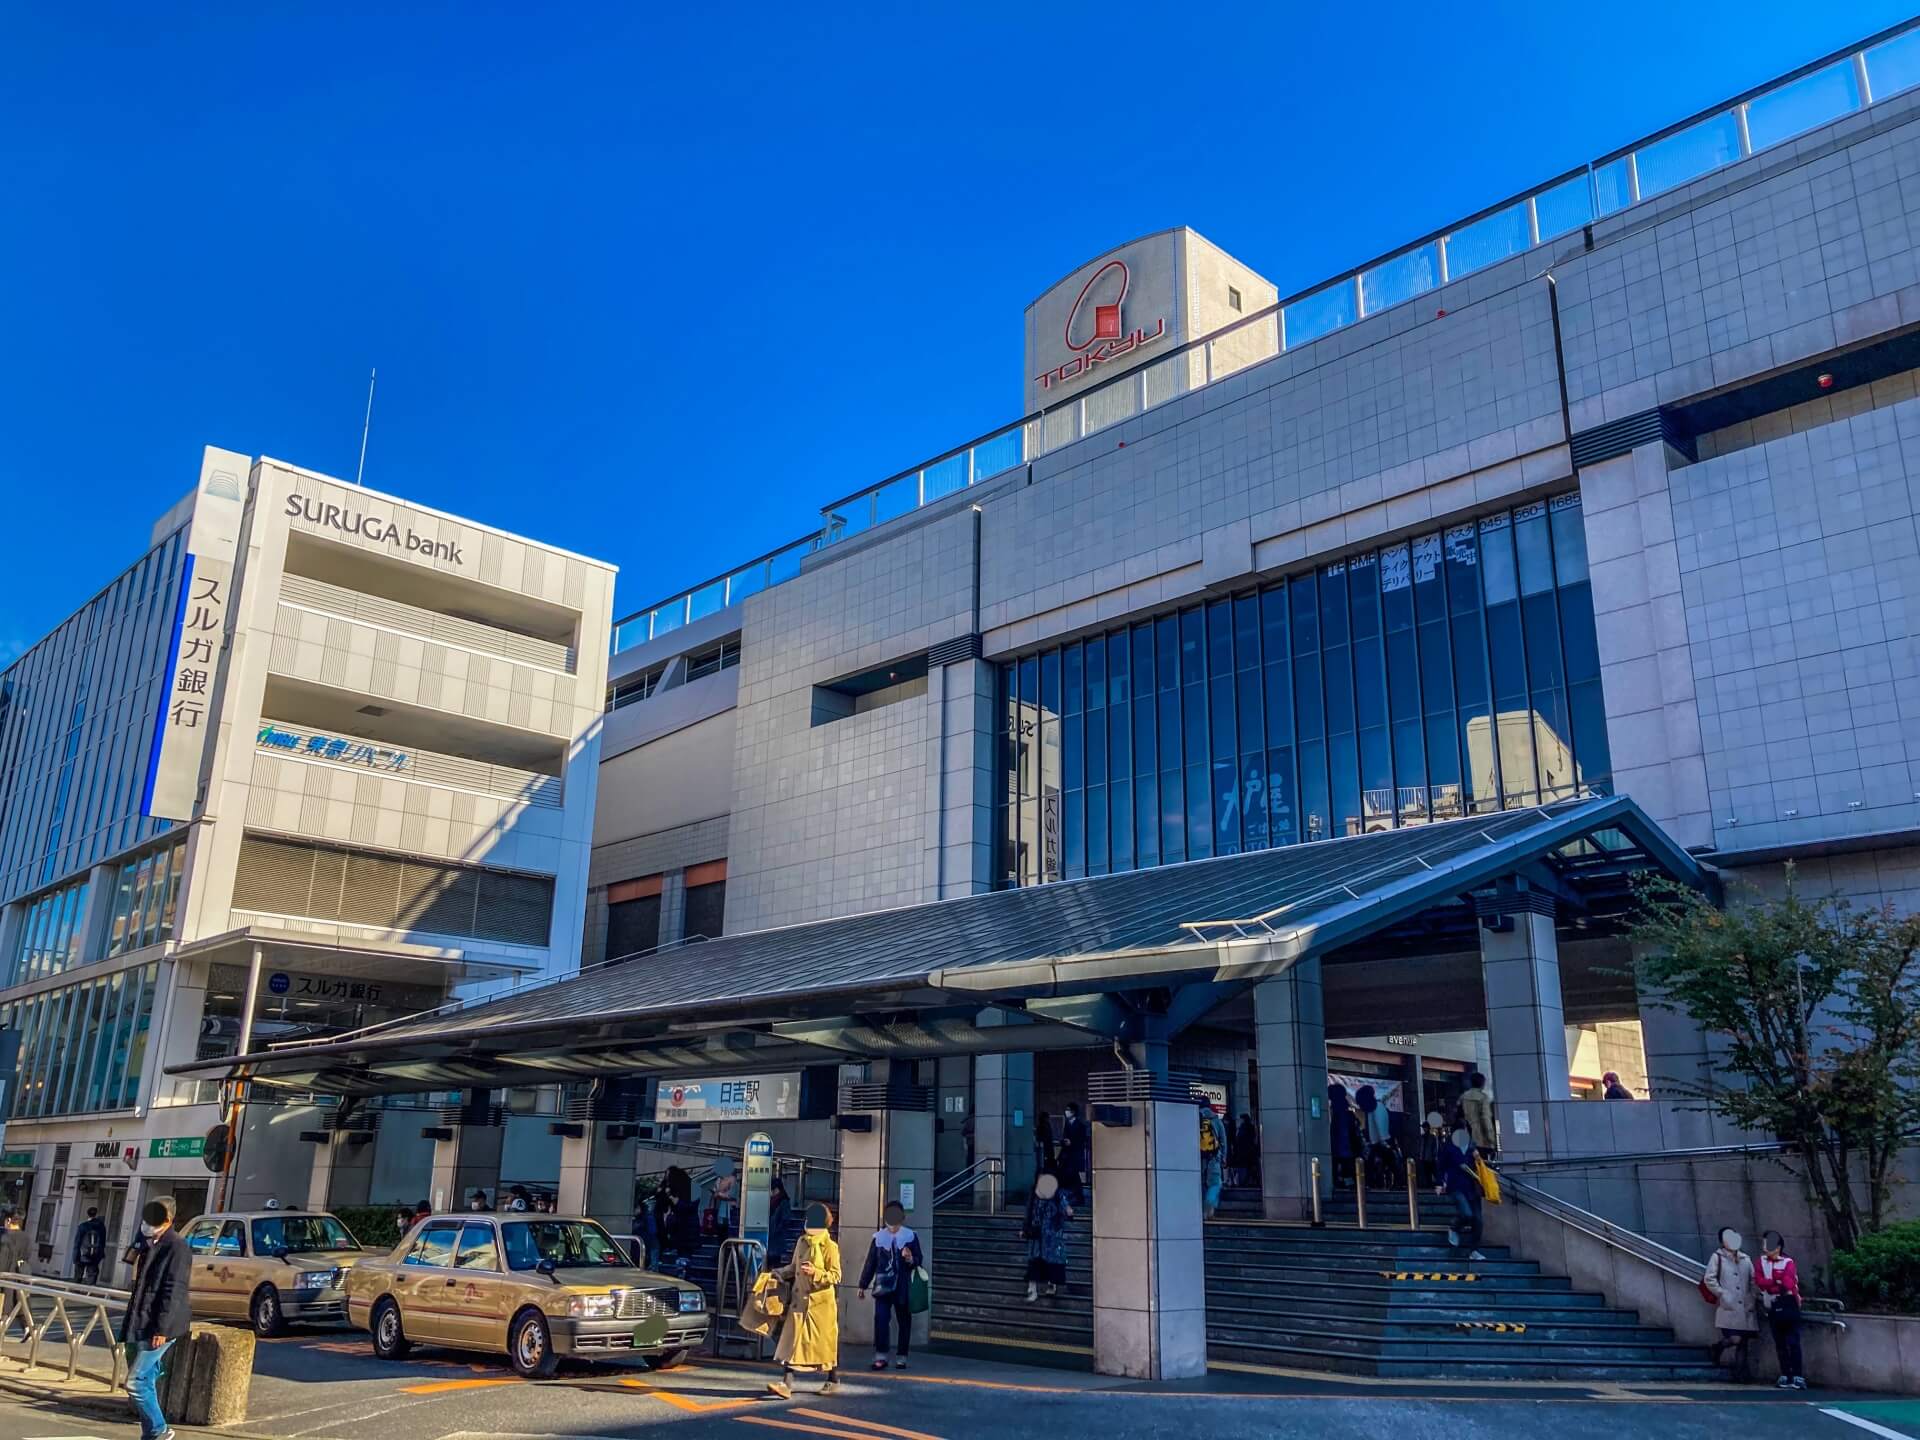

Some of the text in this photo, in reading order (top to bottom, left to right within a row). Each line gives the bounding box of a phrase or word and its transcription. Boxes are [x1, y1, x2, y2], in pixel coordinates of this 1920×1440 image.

[1034, 318, 1164, 389] TOKYU
[285, 494, 463, 565] SURUGA bank
[172, 577, 221, 728] スルガ銀行
[297, 977, 383, 1001] スルガ銀行
[720, 1080, 760, 1103] 日吉駅
